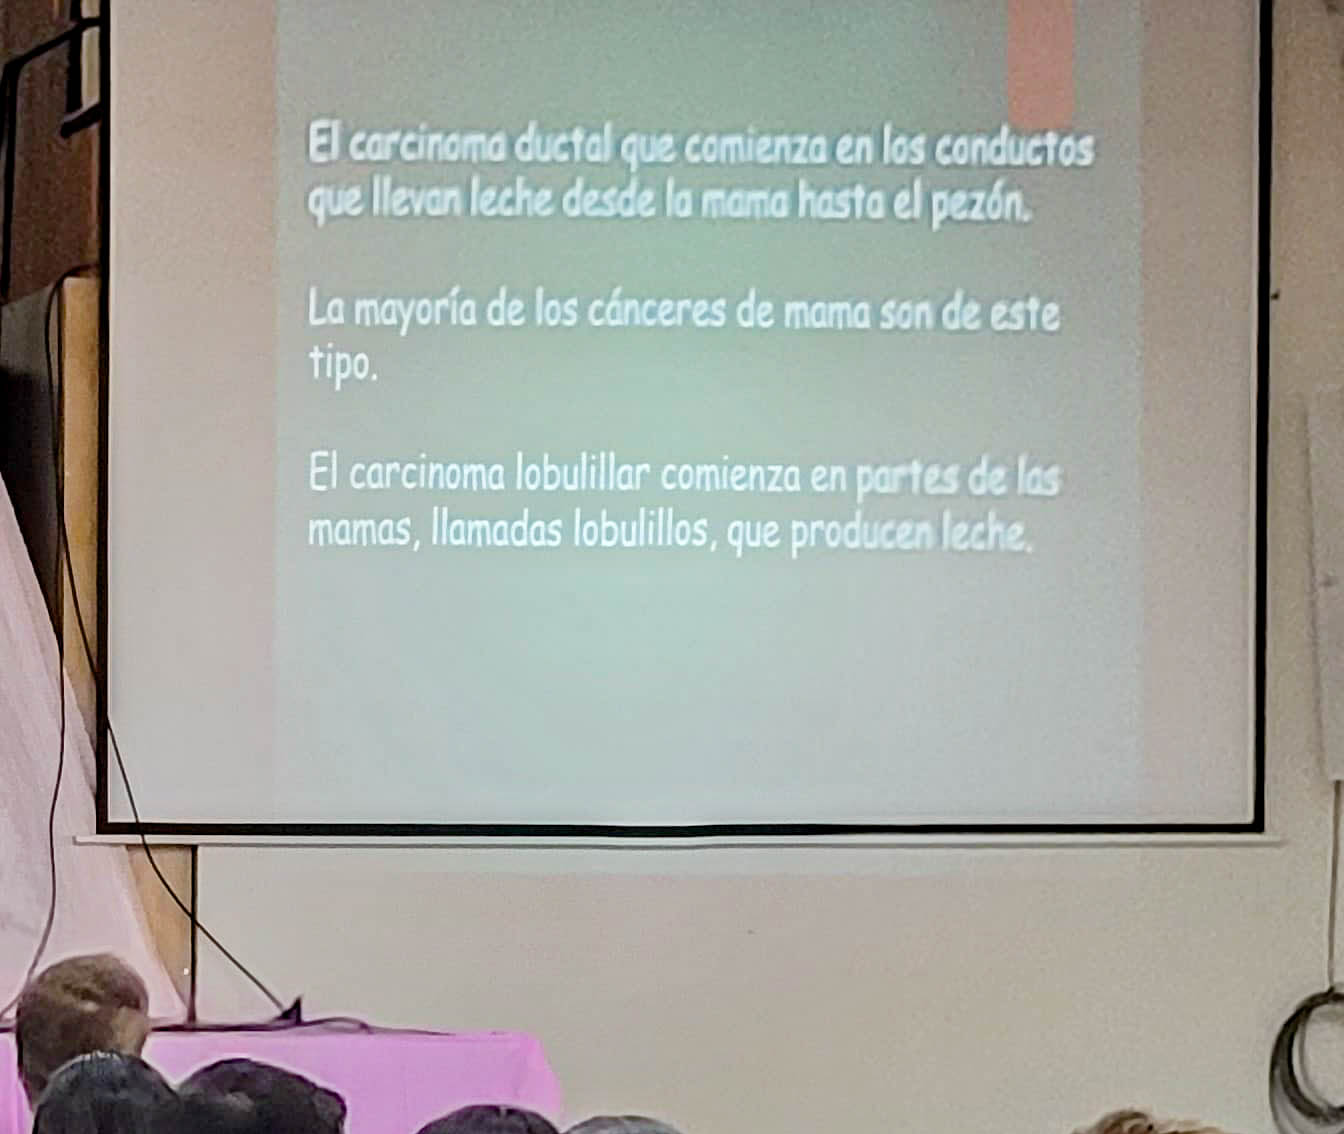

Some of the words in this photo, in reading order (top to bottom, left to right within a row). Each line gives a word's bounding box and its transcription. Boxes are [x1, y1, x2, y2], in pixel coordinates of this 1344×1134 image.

[308, 119, 342, 163] El
[349, 123, 507, 162] carcinoma
[515, 120, 611, 163] ductal
[621, 131, 676, 173] que
[685, 126, 827, 165] comienza
[836, 134, 872, 165] en
[883, 122, 926, 165] los
[935, 123, 1096, 166] conductos
[308, 186, 363, 227] que
[372, 174, 461, 217] llevan
[471, 175, 553, 217] leche
[562, 176, 656, 217] desde
[666, 177, 693, 217] la
[701, 188, 789, 219] mama
[798, 177, 885, 220] hasta
[893, 176, 920, 220] el
[932, 178, 1033, 231] pezón.
[308, 286, 344, 325] La
[354, 286, 476, 337] mayoría
[487, 286, 526, 326] de
[535, 286, 577, 325] los
[588, 286, 726, 327] cánceres
[736, 289, 774, 328] de
[784, 299, 871, 330] mama
[880, 299, 933, 330] son
[942, 289, 981, 330] de
[991, 296, 1060, 331] este
[308, 343, 378, 391] tipo.
[310, 450, 337, 491] El
[350, 453, 505, 490] carcinoma
[516, 451, 650, 491] lobulillar
[661, 456, 800, 492] comienza
[811, 465, 846, 492] en
[856, 460, 958, 504] partes
[968, 454, 1006, 495] de
[1017, 452, 1063, 496] las
[308, 516, 420, 552] mamas,
[432, 506, 562, 547] llamadas
[574, 507, 717, 552] lobulillos,
[727, 519, 781, 557] que
[791, 509, 932, 559] producen
[942, 508, 1033, 553] leche.
